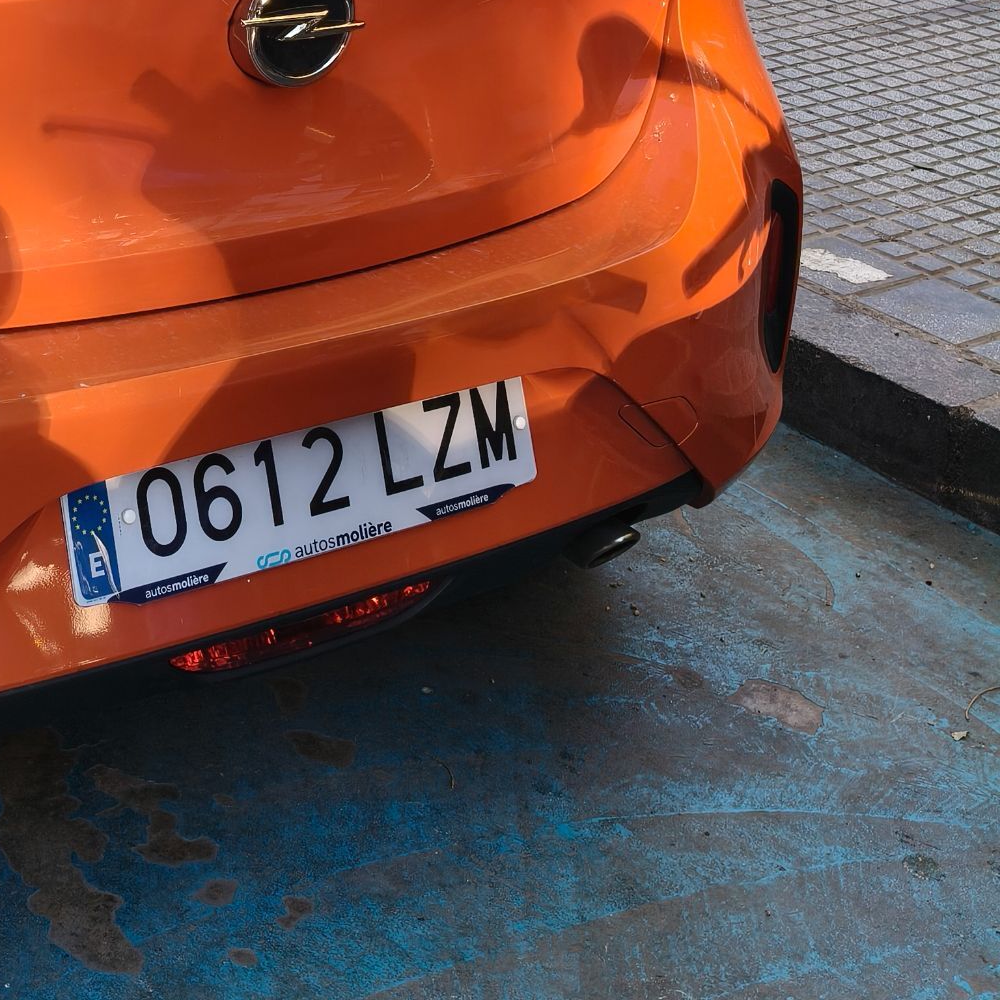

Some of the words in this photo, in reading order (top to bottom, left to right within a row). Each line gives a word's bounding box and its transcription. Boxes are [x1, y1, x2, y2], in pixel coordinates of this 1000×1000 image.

[136, 426, 351, 558] 0612
[374, 380, 518, 496] LZM
[436, 493, 489, 516] autosmolière
[295, 520, 393, 559] autosmolière
[89, 551, 106, 578] E
[145, 573, 210, 599] autosmolière
